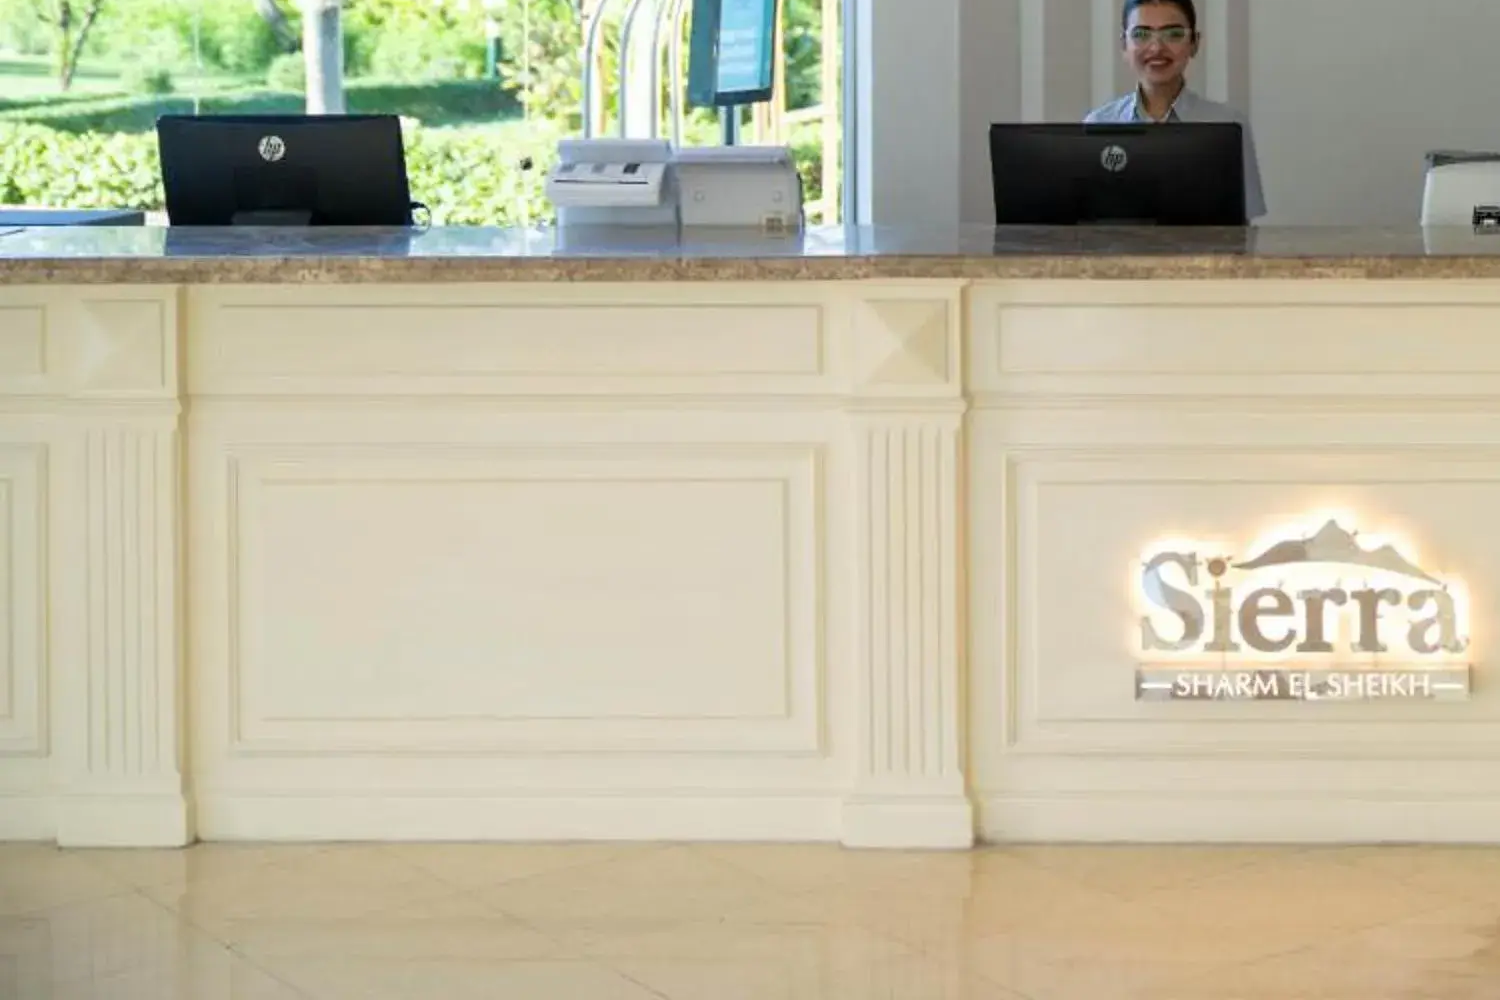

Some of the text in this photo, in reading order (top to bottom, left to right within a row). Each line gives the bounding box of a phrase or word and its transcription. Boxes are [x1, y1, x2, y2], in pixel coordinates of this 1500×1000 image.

[1141, 551, 1469, 653] Sierra
[1176, 672, 1430, 697] SHARM EL SHEIKH
